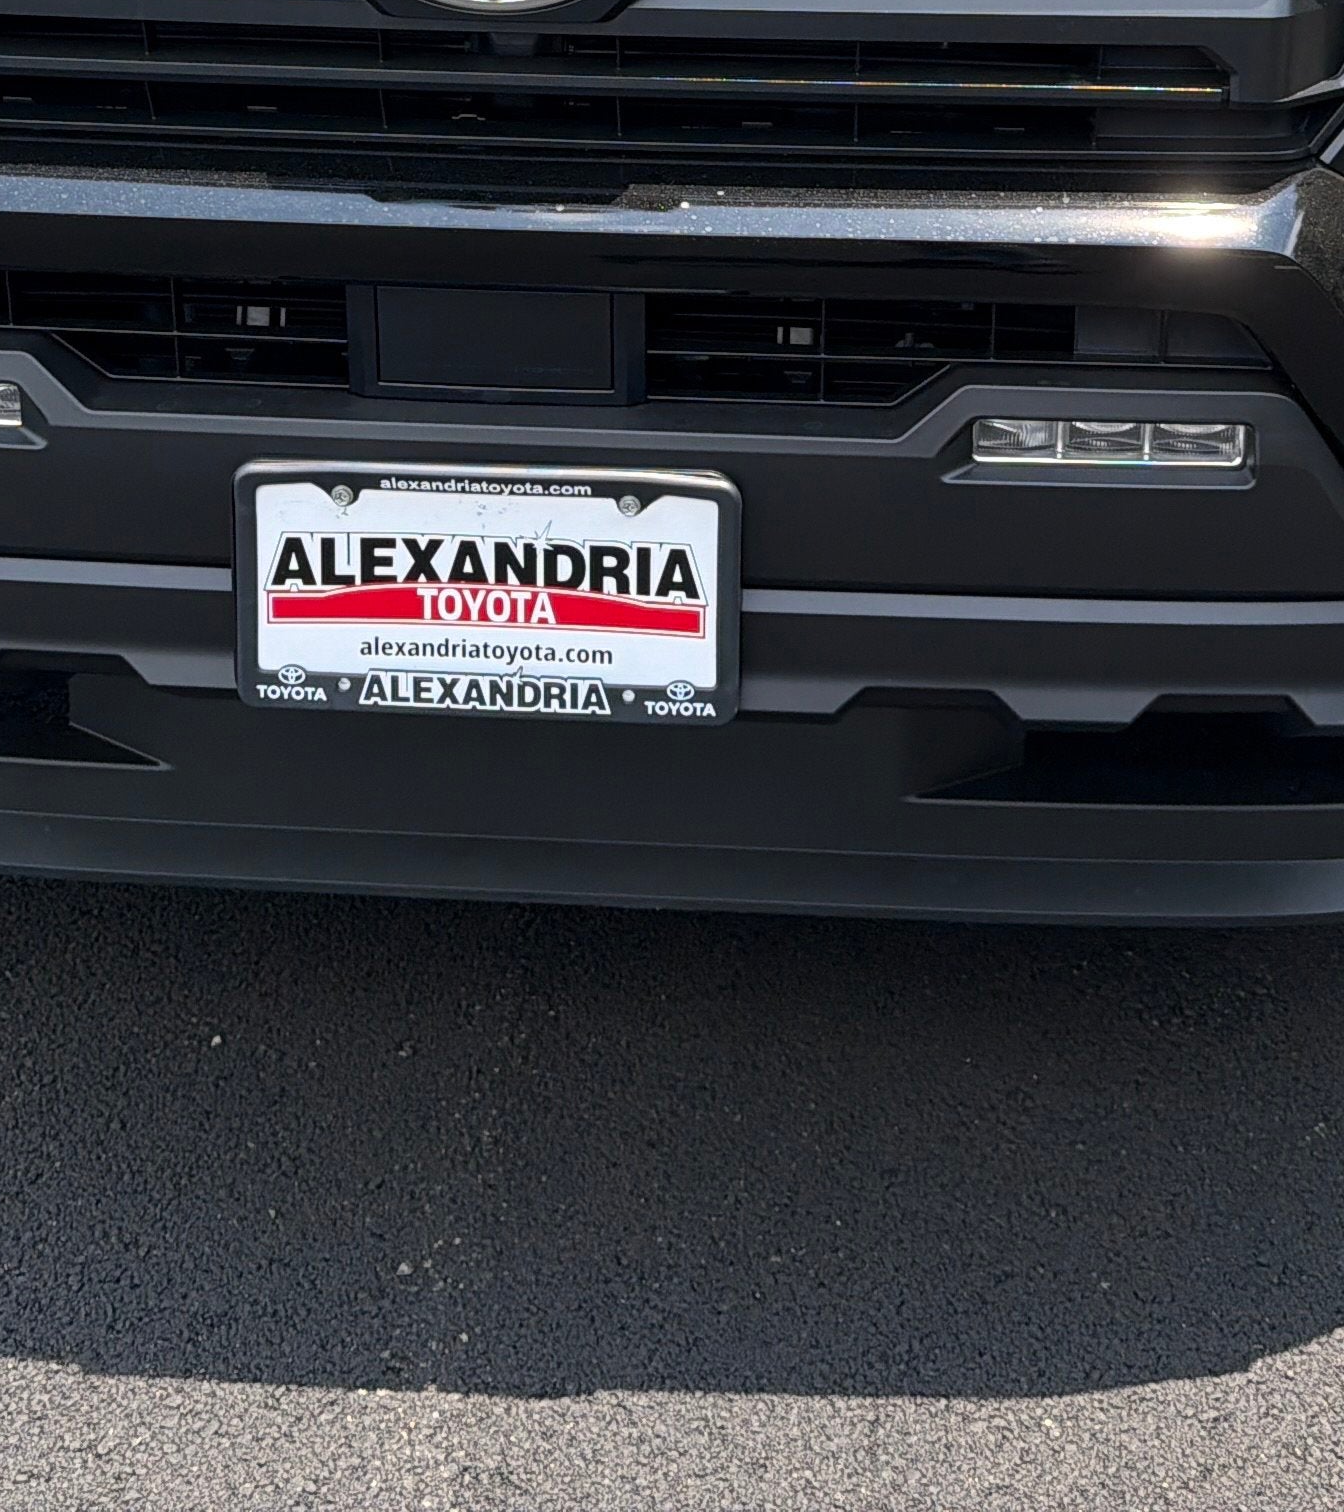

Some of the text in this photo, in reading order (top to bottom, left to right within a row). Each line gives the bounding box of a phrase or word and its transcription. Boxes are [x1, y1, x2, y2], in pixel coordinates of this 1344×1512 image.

[379, 476, 592, 497] alexandriatoyota.com
[271, 534, 702, 601] ALEXANDRIA
[417, 586, 557, 625] TOYOTA
[359, 636, 614, 665] alexandriatoyota.com
[257, 684, 327, 702] TOYOTA
[359, 668, 611, 715] ALEXANDRIA
[645, 700, 716, 718] TOYOTA
